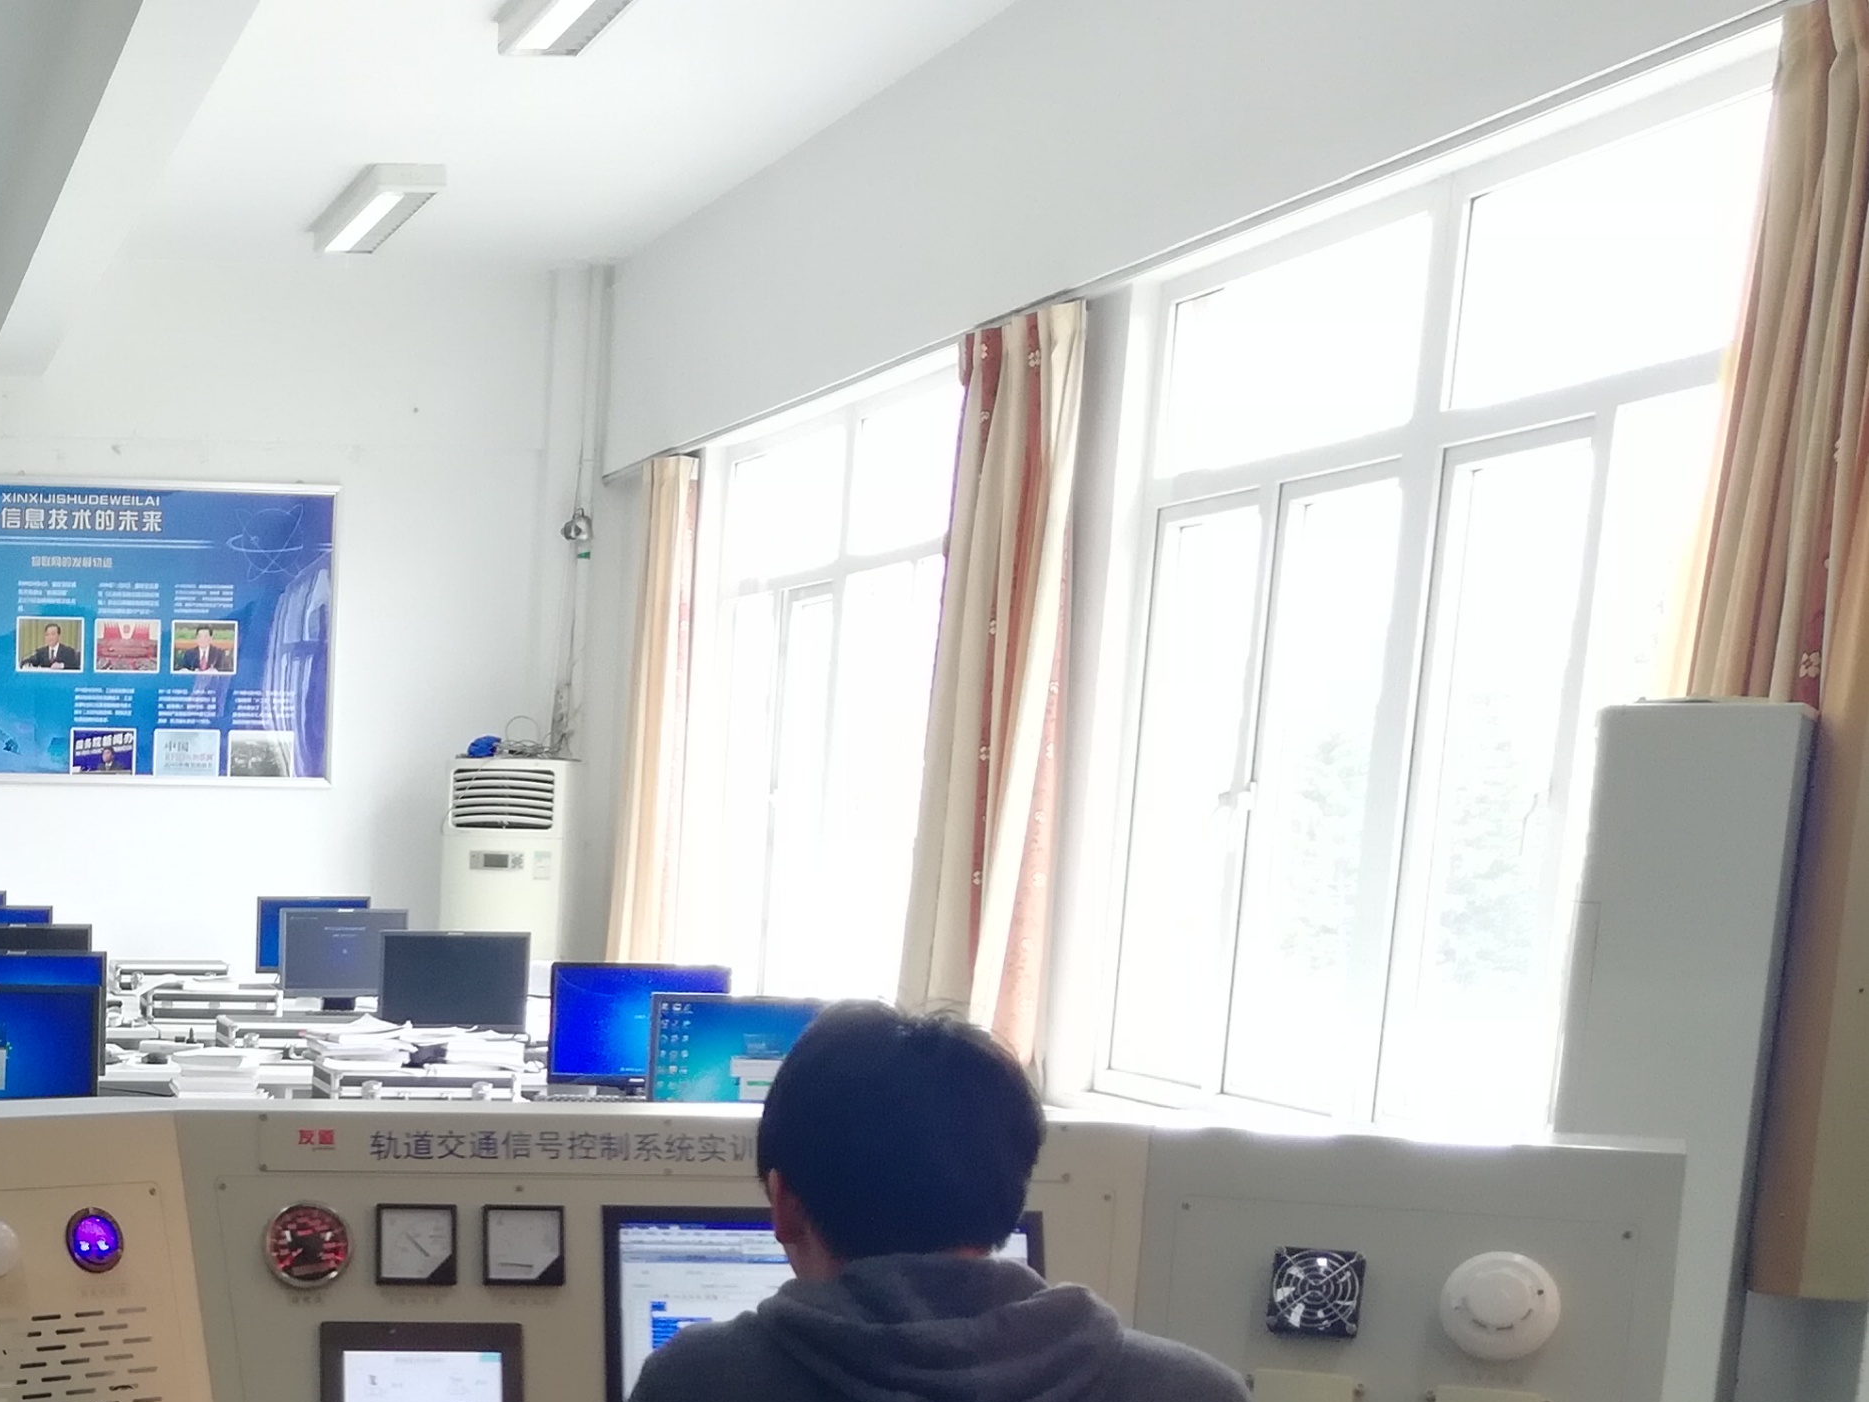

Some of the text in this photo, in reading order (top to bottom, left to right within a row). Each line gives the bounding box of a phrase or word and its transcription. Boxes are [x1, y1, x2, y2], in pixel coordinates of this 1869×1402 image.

[2, 492, 161, 506] XINXIJISHUDEWEILAI
[369, 1130, 757, 1162] 轨道交通信号控制系统实训
